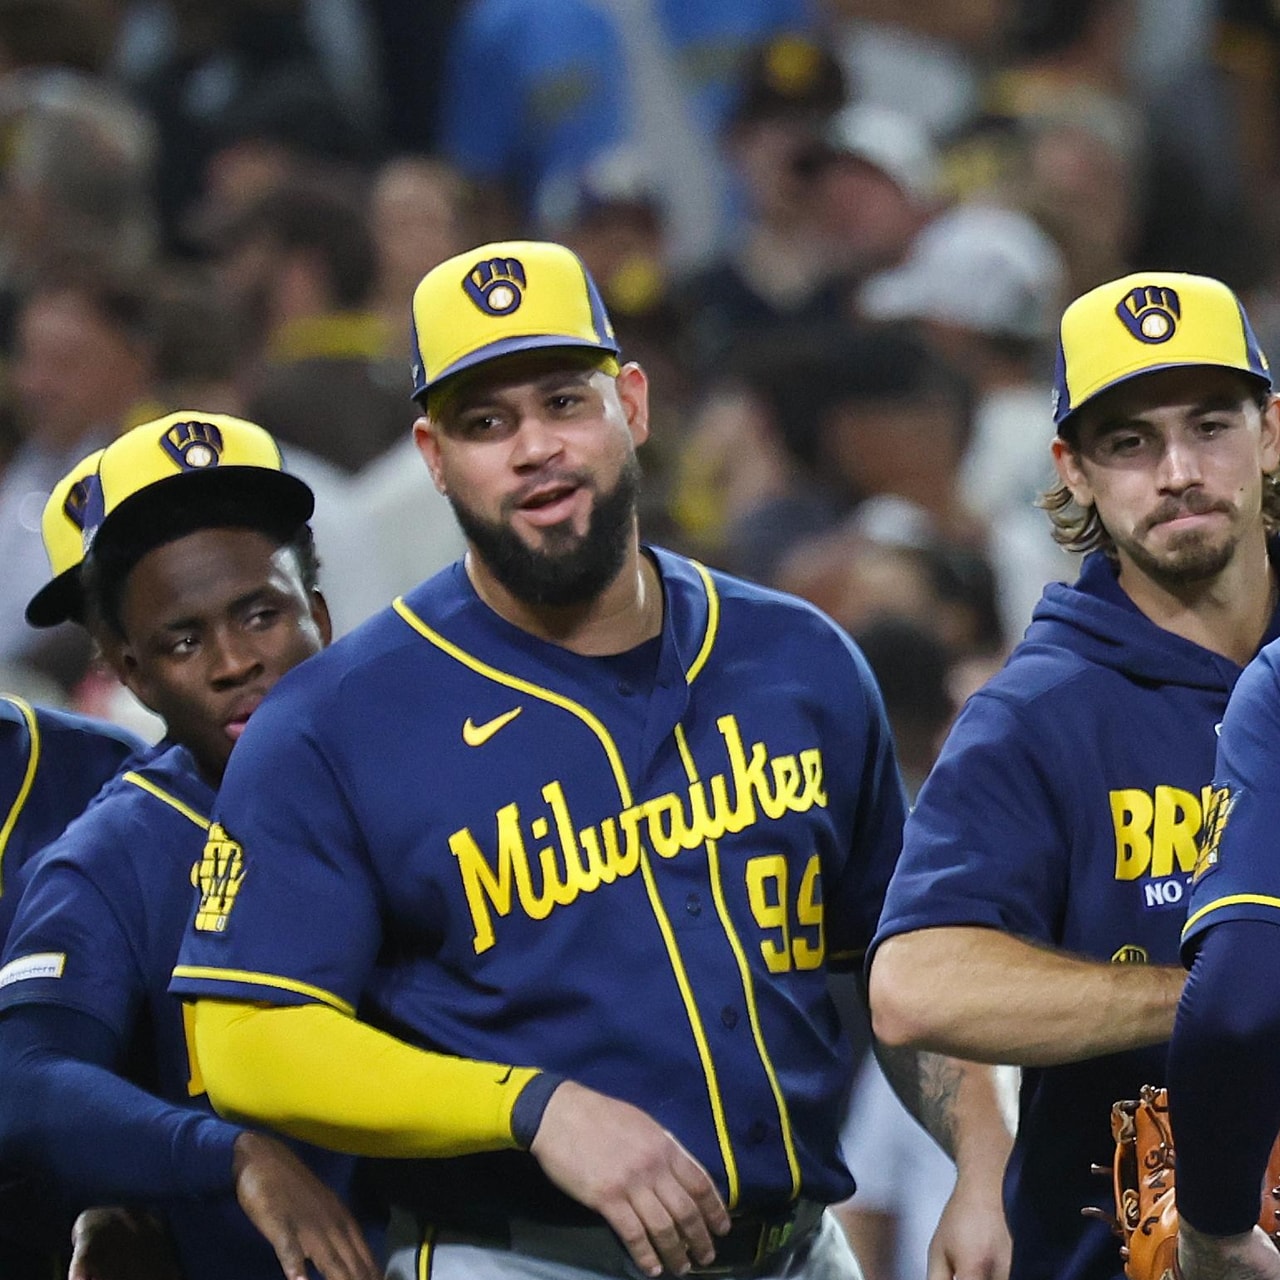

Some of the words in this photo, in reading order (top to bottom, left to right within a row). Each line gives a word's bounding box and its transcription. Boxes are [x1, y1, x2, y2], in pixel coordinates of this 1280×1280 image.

[448, 714, 828, 956] Milwaukee
[1144, 879, 1183, 907] NO
[745, 854, 826, 974] 99
